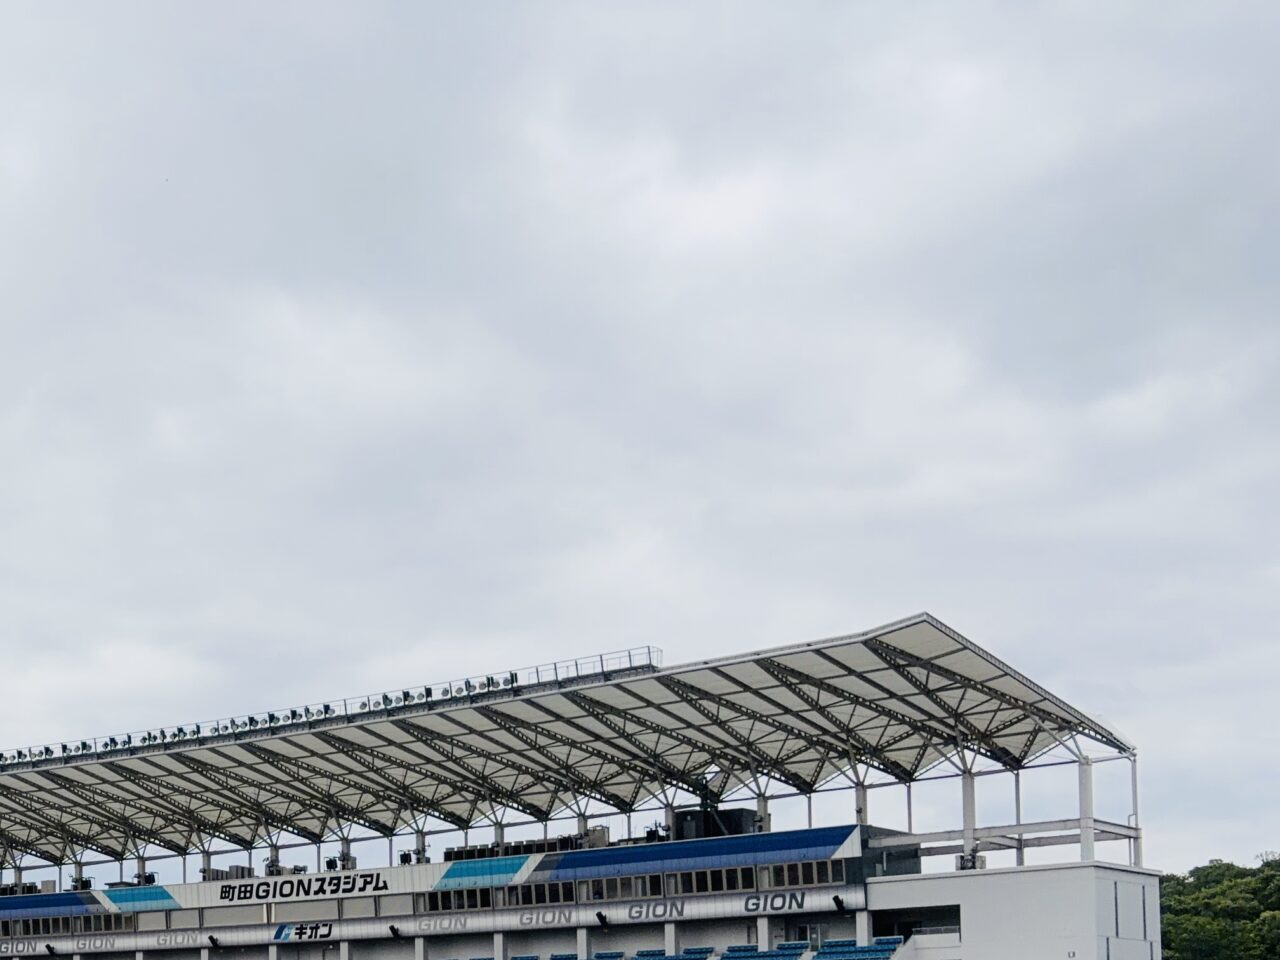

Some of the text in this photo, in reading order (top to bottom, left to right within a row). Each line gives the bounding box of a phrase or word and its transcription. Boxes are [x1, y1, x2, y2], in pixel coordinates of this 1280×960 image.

[220, 872, 389, 901] 町田GIONスタジアム
[744, 891, 807, 913] GION
[520, 910, 573, 926] GION
[628, 901, 685, 920] GION
[294, 923, 333, 940] ギオン
[417, 916, 468, 932] GION
[76, 935, 116, 950] GION
[156, 931, 199, 946] GION
[0, 940, 38, 954] GION
